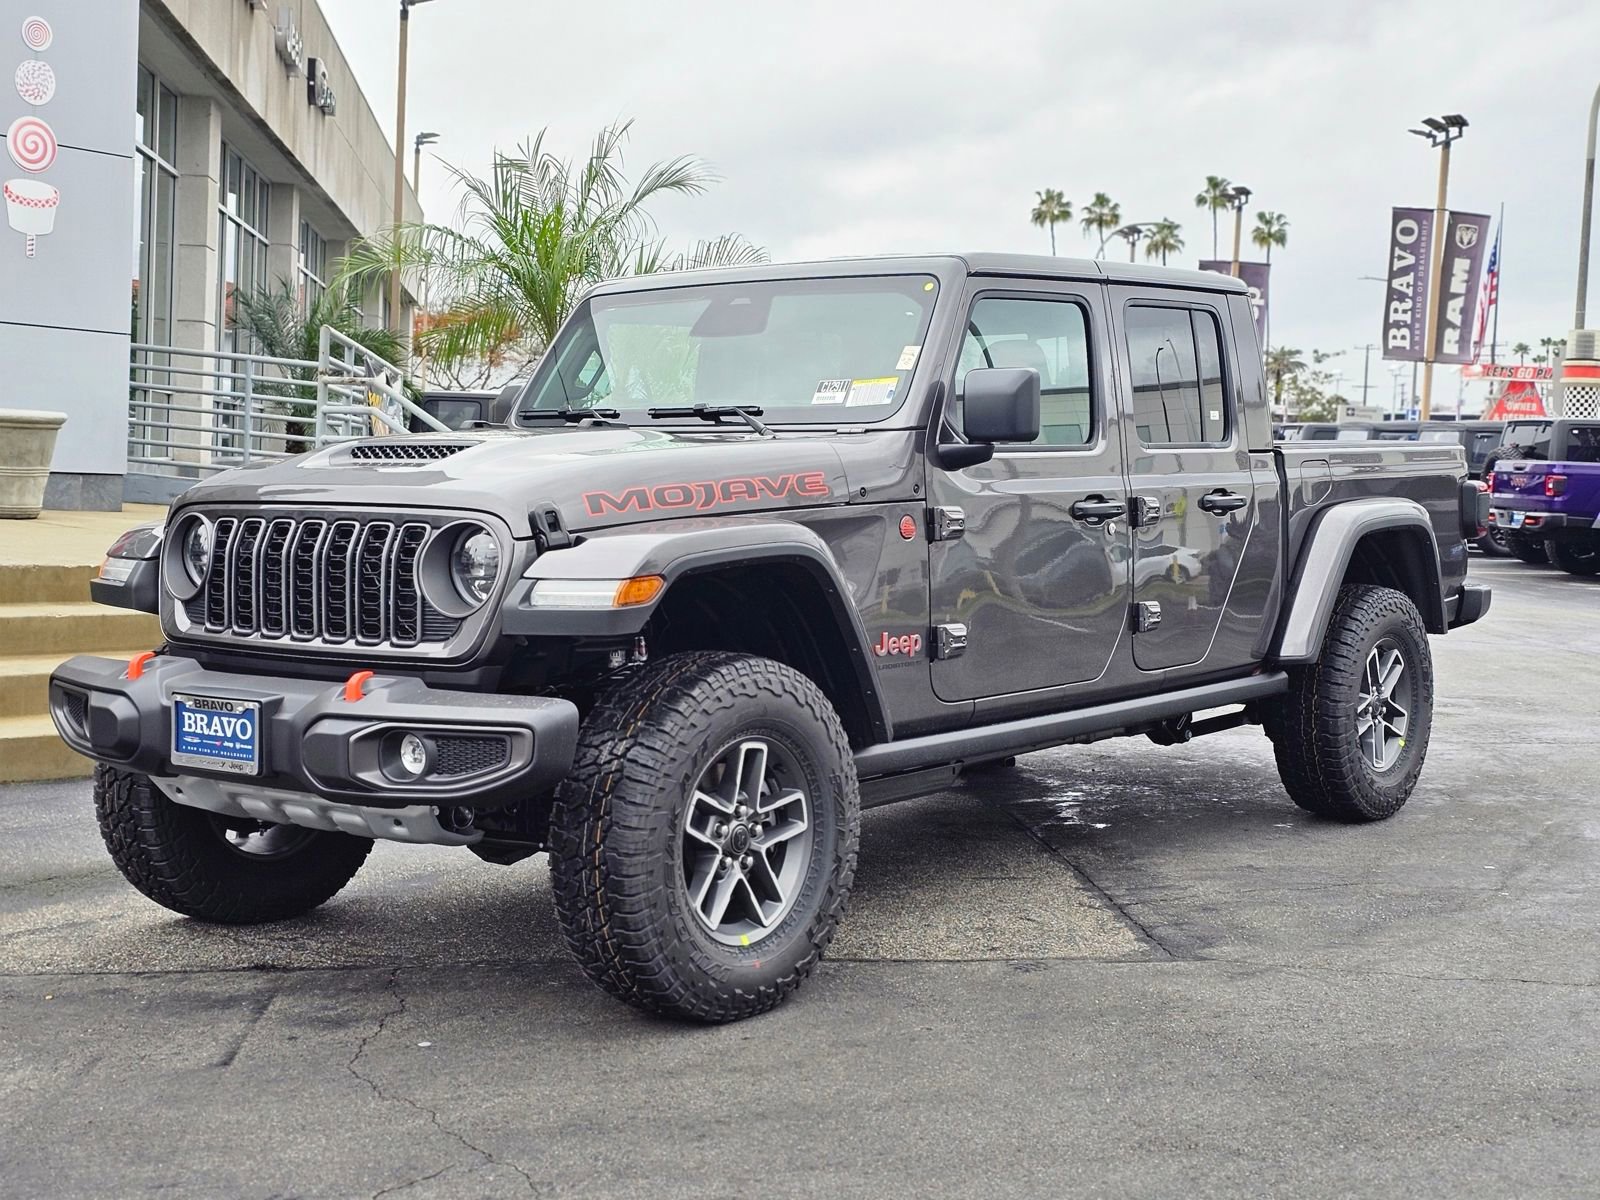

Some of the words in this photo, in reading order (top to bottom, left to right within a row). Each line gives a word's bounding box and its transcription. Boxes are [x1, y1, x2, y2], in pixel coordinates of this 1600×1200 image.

[1418, 219, 1429, 277] DEALERSHIP
[1388, 218, 1419, 350] BRAVO
[1417, 281, 1424, 293] OF
[1442, 257, 1472, 355] RAM
[1486, 366, 1514, 378] LET'S
[1516, 367, 1533, 378] GO
[583, 472, 830, 516] MOJAVE
[874, 631, 922, 657] Jeep
[194, 698, 234, 712] BRAVO
[182, 711, 253, 740] BRAVO
